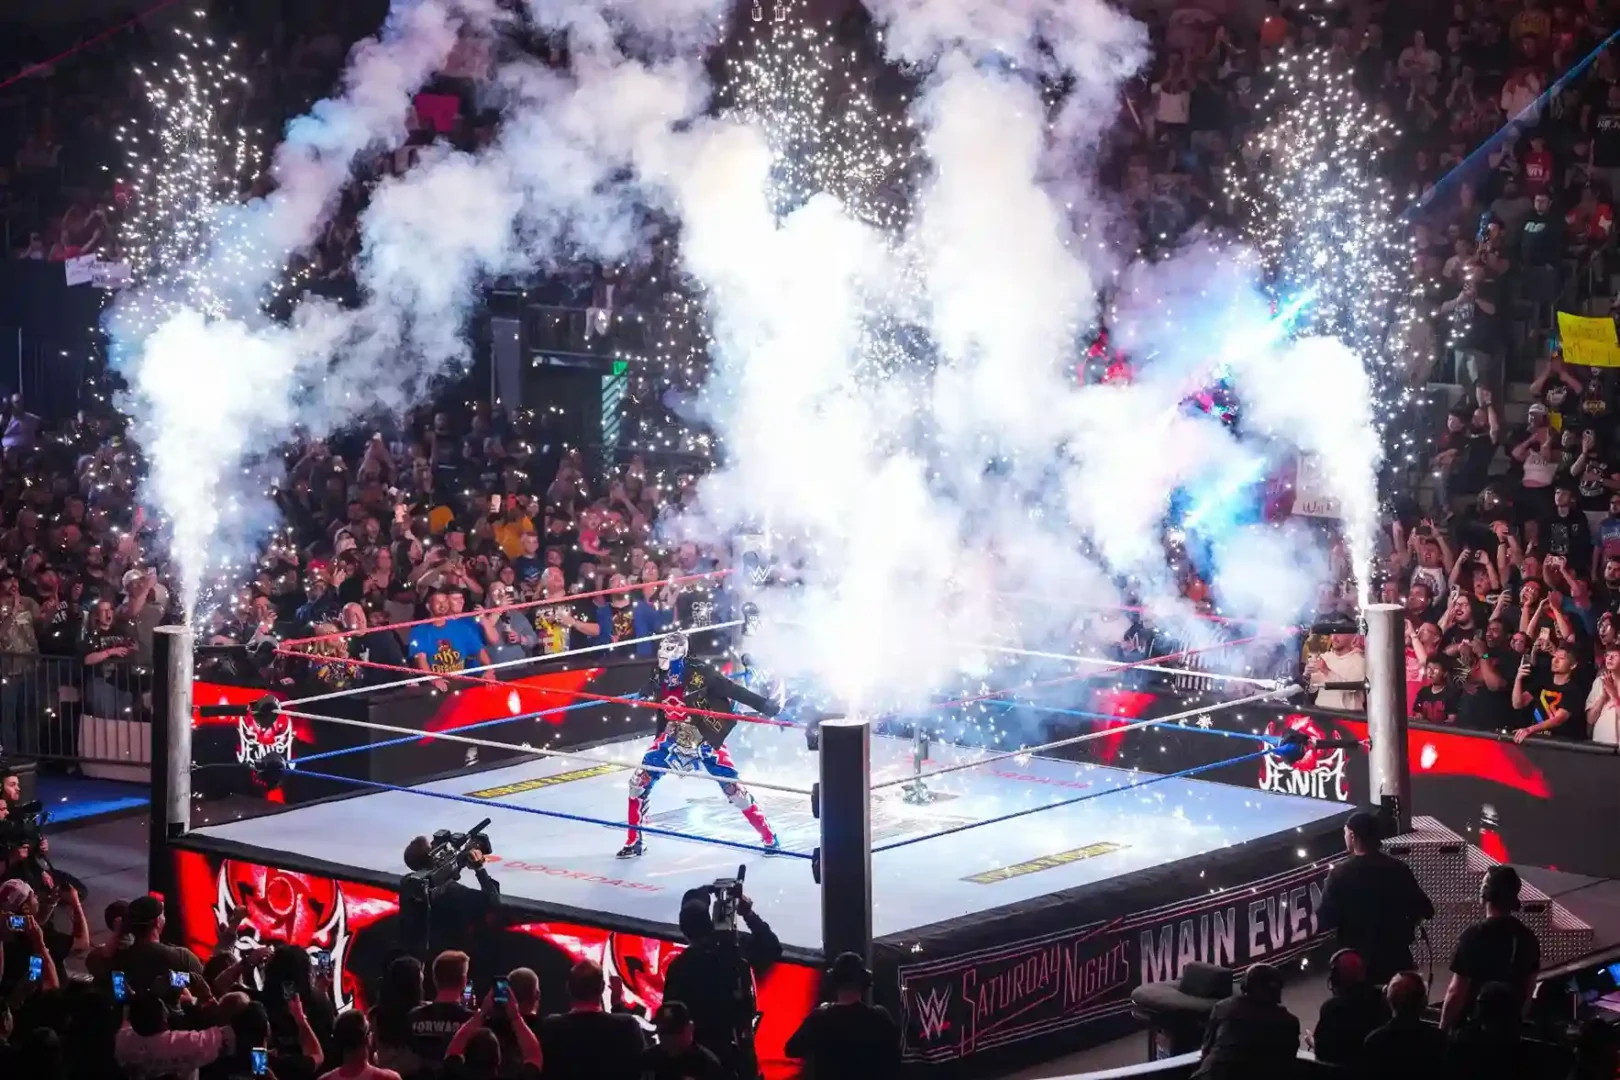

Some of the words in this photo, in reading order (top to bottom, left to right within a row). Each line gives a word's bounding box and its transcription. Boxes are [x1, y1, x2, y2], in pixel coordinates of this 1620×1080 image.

[691, 601, 713, 611] CSC
[961, 943, 1061, 1057] SATURDAY
[1063, 939, 1130, 1009] NIGHT'S
[1140, 907, 1236, 986] MAIN
